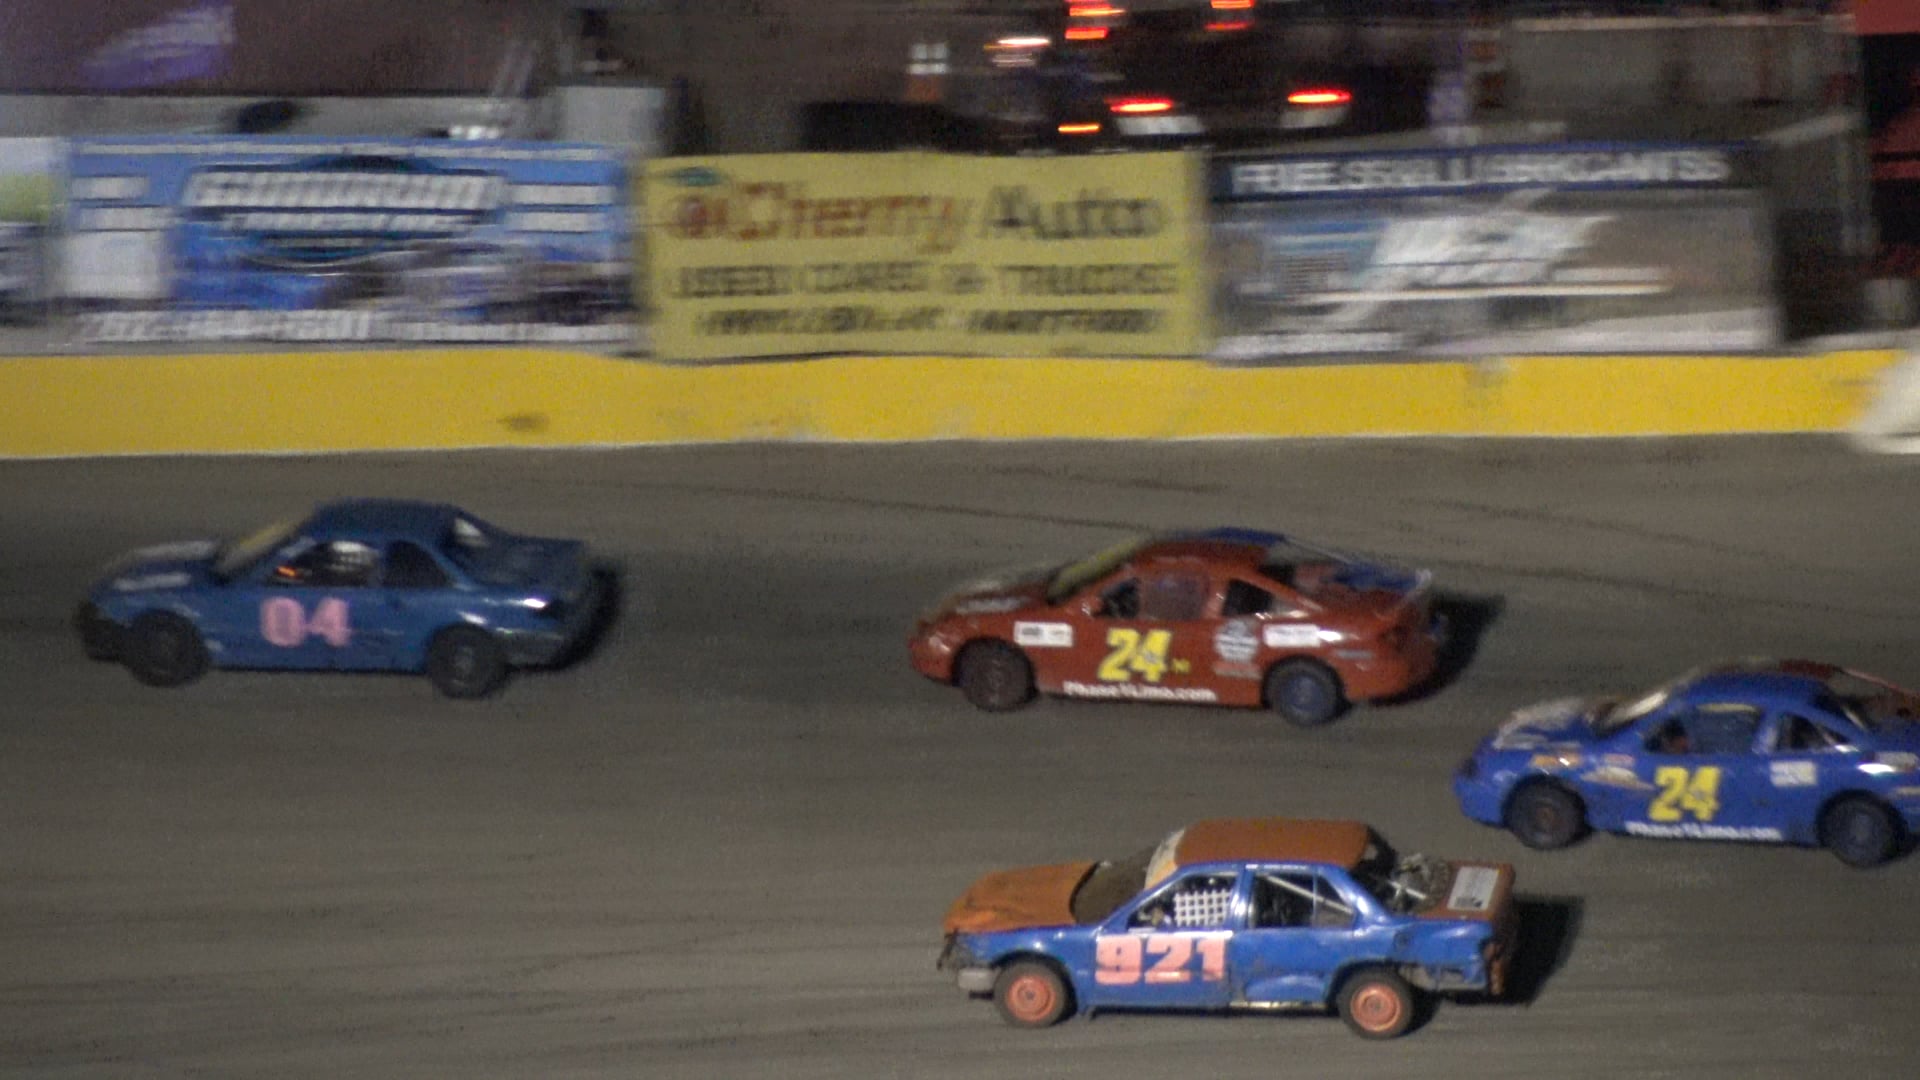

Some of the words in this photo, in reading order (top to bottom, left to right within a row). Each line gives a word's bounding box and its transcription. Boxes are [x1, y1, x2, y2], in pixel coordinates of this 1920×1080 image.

[727, 181, 962, 255] Cherry
[980, 184, 1163, 240] Auto
[803, 261, 928, 294] CARS
[1000, 262, 1178, 294] TRUCKS
[260, 597, 349, 648] 04
[1097, 627, 1171, 682] 24
[1648, 766, 1721, 821] 24
[1095, 935, 1227, 985] 921
